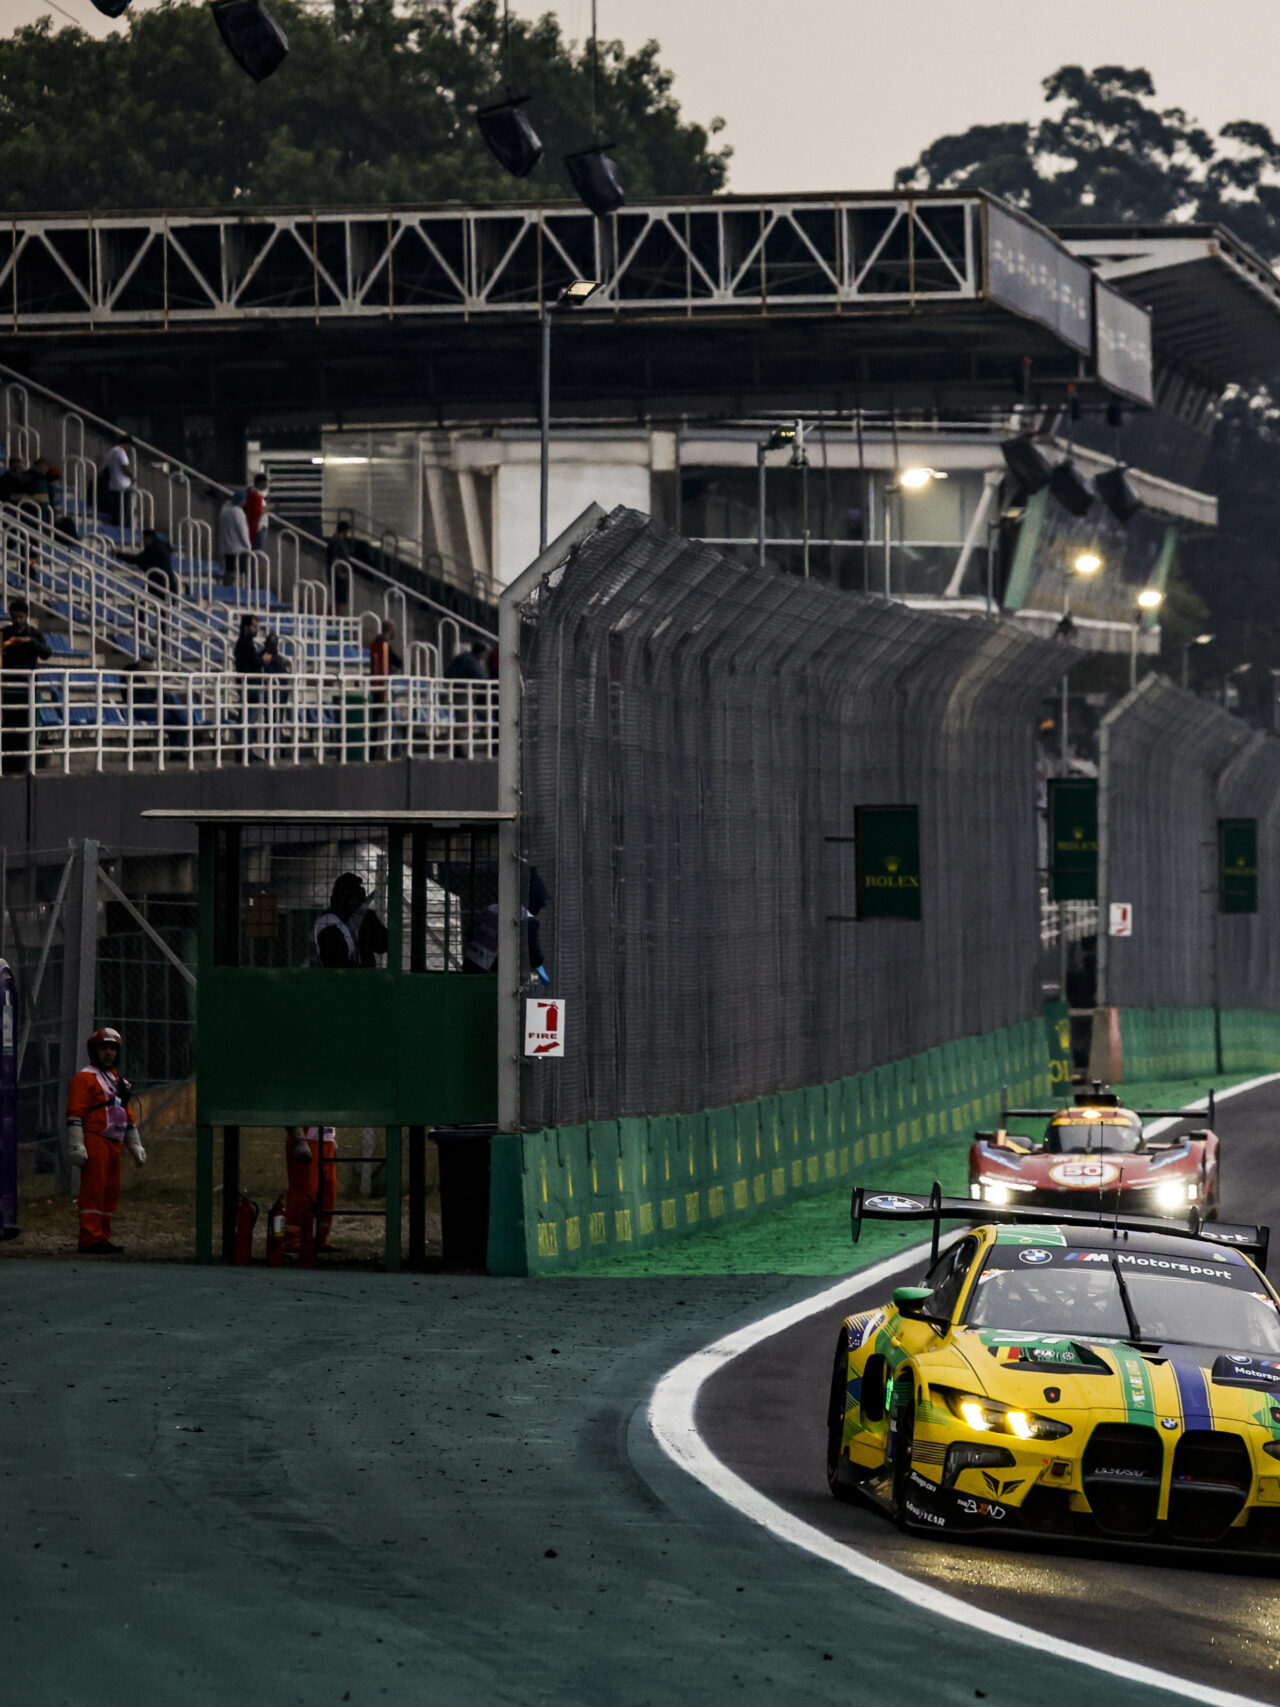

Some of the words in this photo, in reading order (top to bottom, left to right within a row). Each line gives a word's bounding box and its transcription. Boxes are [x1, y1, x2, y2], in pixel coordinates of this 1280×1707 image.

[865, 875, 919, 887] ROLEX
[1064, 1166, 1102, 1176] 50
[1117, 1254, 1232, 1280] Motorsport
